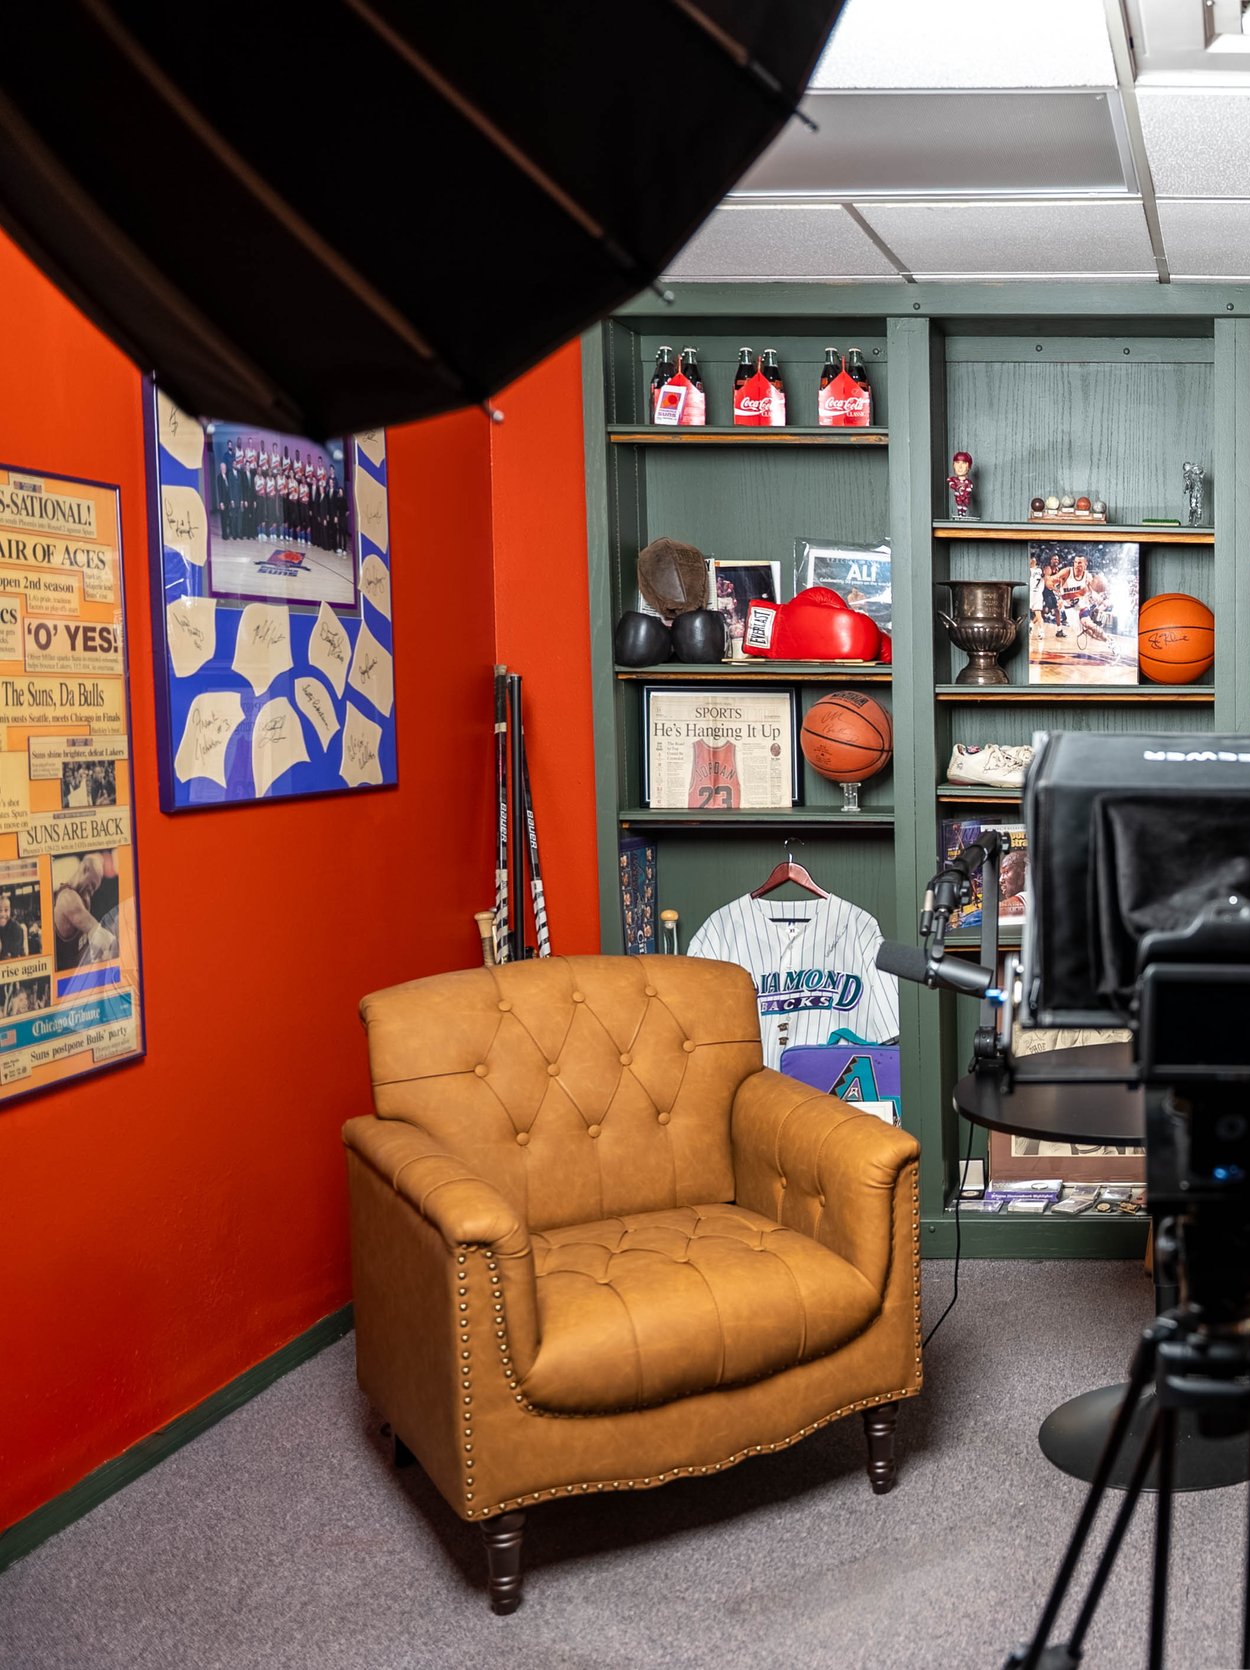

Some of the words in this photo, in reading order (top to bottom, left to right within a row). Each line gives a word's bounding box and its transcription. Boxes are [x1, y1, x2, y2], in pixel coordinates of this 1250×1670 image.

[824, 396, 865, 411] Coca-Cola
[32, 542, 56, 564] OF
[61, 544, 106, 570] ACES
[23, 576, 41, 590] 2nd
[44, 582, 74, 594] season
[64, 624, 118, 653] YES!
[750, 610, 771, 645] EVERLAST
[2, 681, 24, 707] The
[28, 681, 56, 711] Suns,
[59, 682, 75, 707] Da
[78, 682, 104, 708] Bulls
[103, 713, 121, 722] Finals
[695, 707, 742, 719] SPORTS
[653, 722, 682, 737] He's
[686, 723, 743, 740] Hanging
[747, 724, 757, 738] It
[761, 724, 781, 740] Up
[105, 747, 124, 757] Lakers
[696, 762, 736, 781] JORDAN
[698, 785, 733, 808] 23
[26, 823, 61, 845] SUNS
[62, 821, 88, 841] ARE
[91, 818, 124, 838] BACK
[526, 810, 538, 850] BAUER
[1, 967, 20, 979] rise
[21, 961, 48, 976] again
[759, 968, 864, 1012] IAMOND
[760, 996, 831, 1012] BACKS
[32, 1016, 68, 1037] Chicago
[68, 1008, 101, 1026] Tribune
[30, 1049, 50, 1062] Suns
[52, 1039, 85, 1057] postpone
[108, 1026, 128, 1040] party
